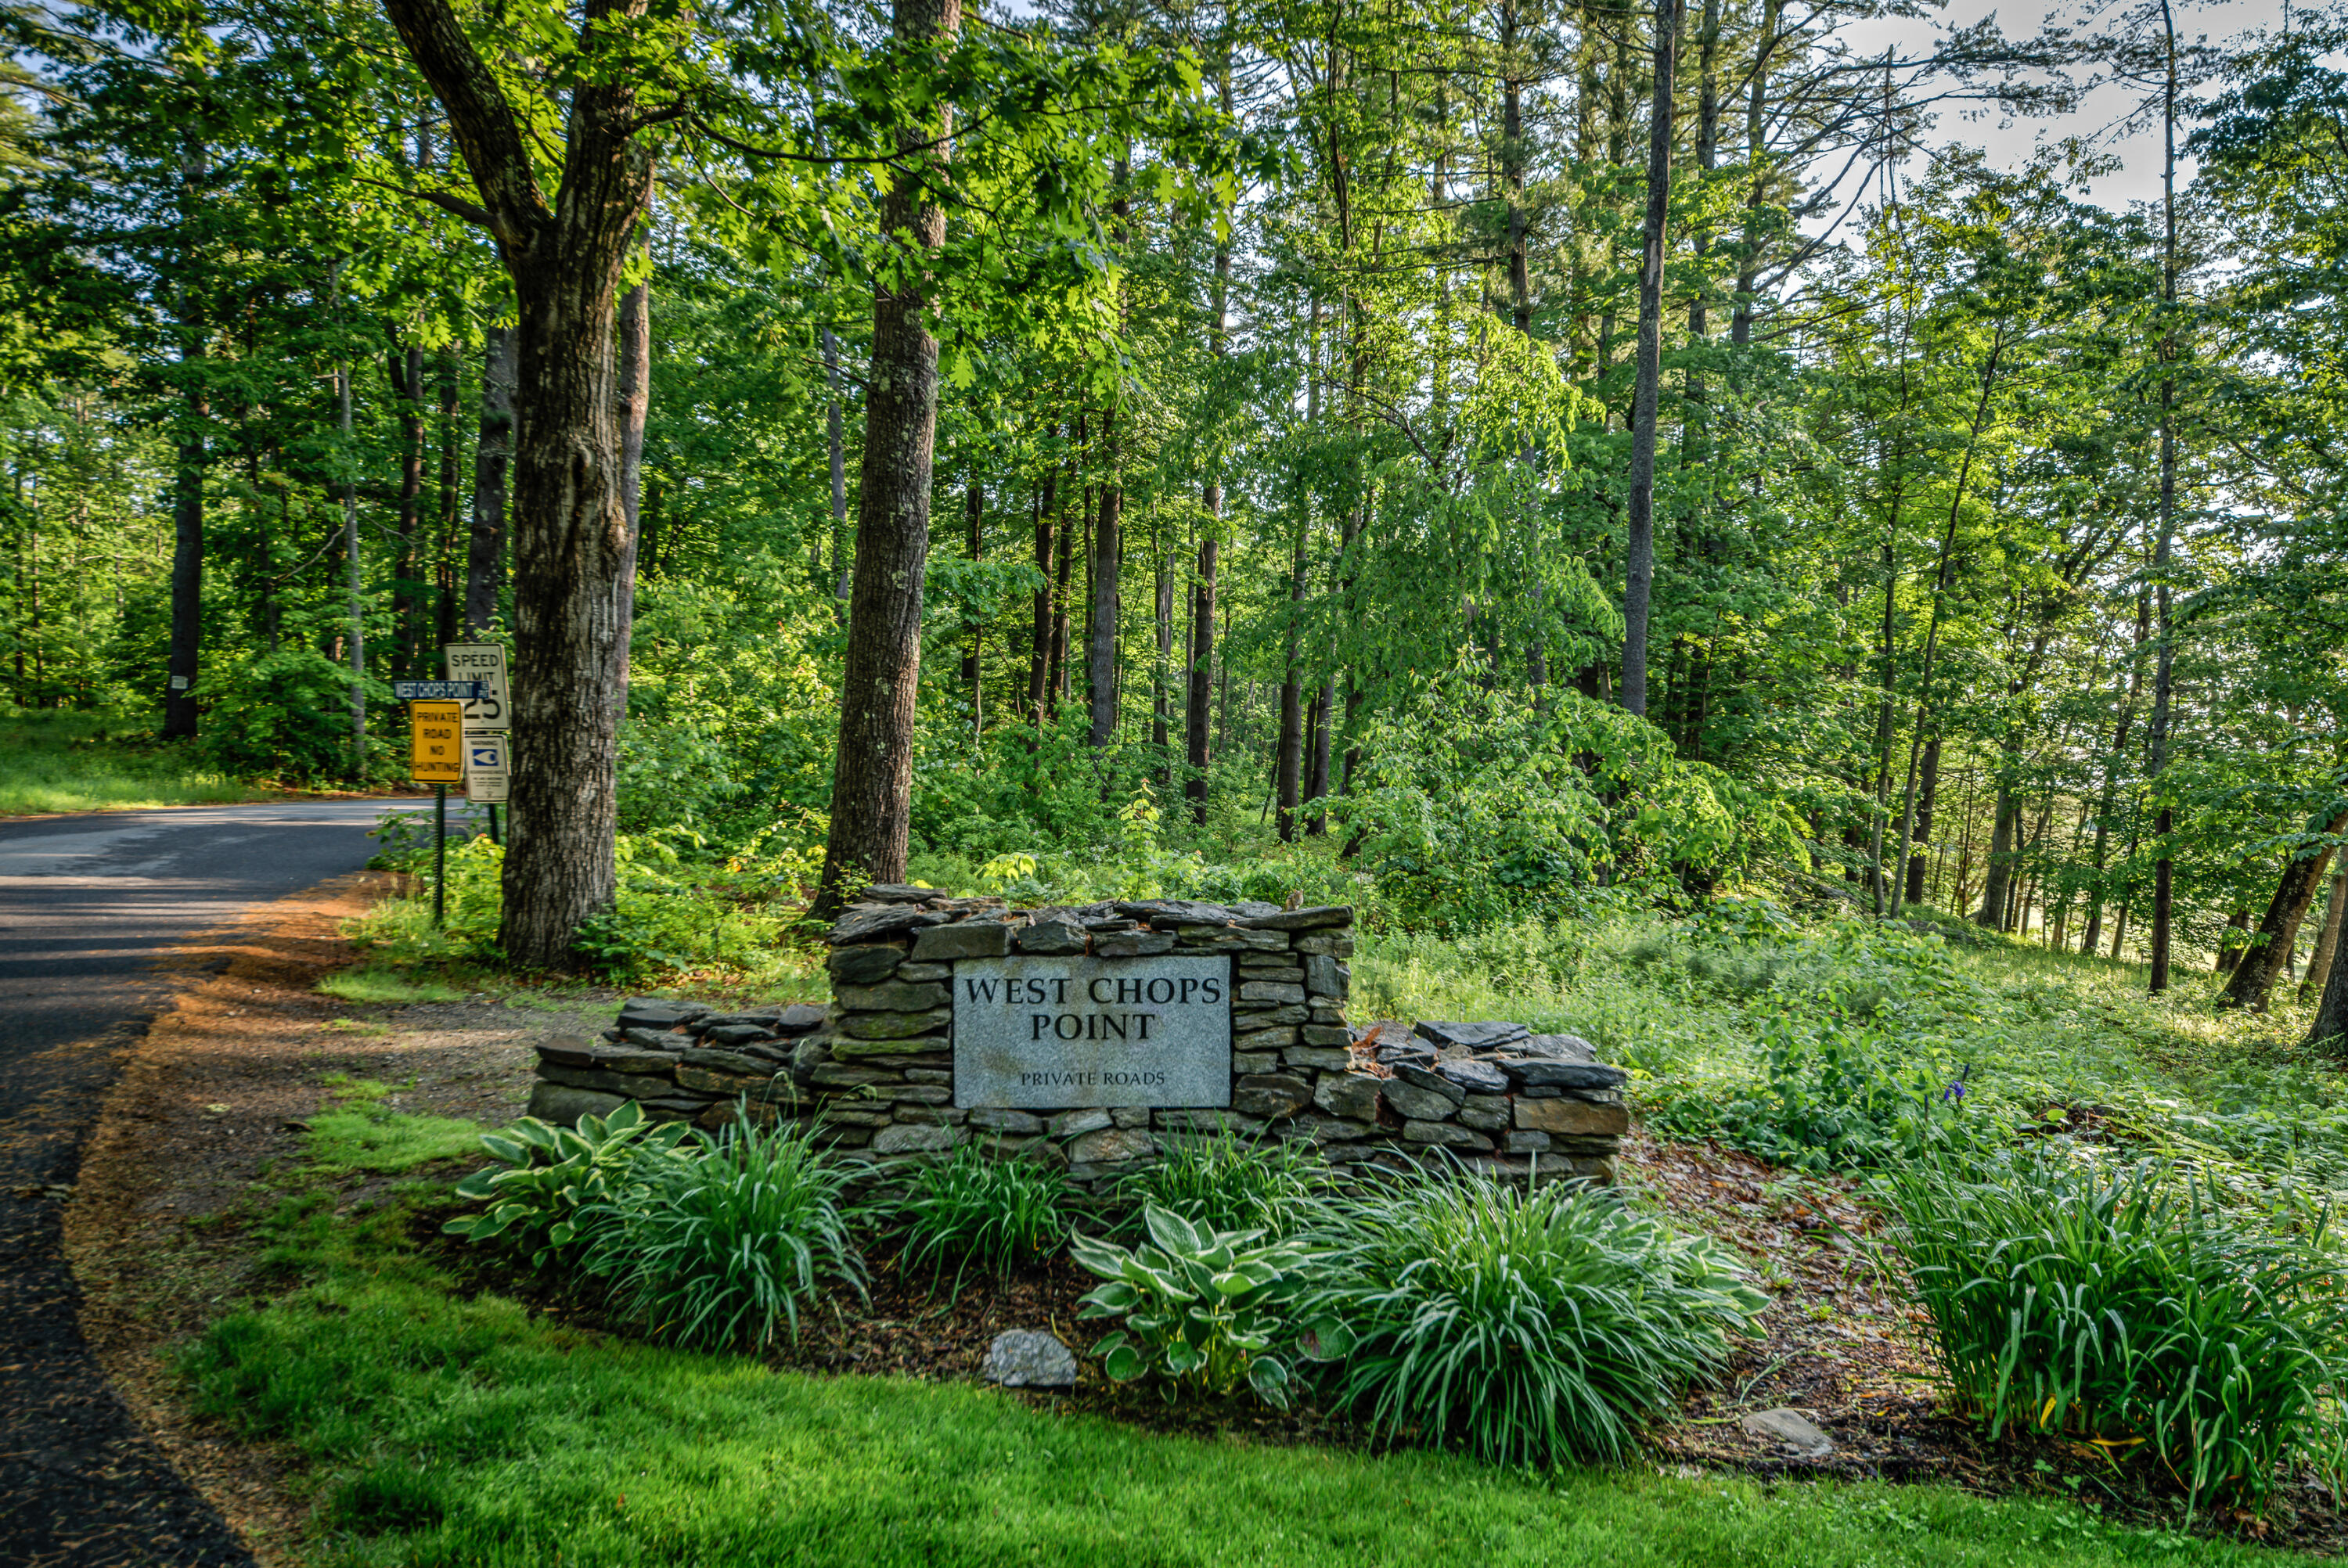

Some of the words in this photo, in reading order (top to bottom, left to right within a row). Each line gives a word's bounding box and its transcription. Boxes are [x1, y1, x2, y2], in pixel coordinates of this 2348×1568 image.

[452, 654, 499, 667] SPEED
[395, 682, 416, 697] WEST
[418, 682, 446, 696] CHOPS
[447, 682, 474, 697] POINT
[465, 690, 501, 719] 25
[416, 712, 458, 722] PRIVATE
[423, 729, 452, 739] ROAD
[430, 746, 445, 755] NO
[416, 762, 459, 772] HUNTING
[965, 978, 1072, 1005] WEST
[1089, 977, 1221, 1005] CHOPS
[1031, 1014, 1155, 1040] POINT
[1021, 1073, 1097, 1085] PRIVATE
[1103, 1073, 1165, 1085] ROADS
